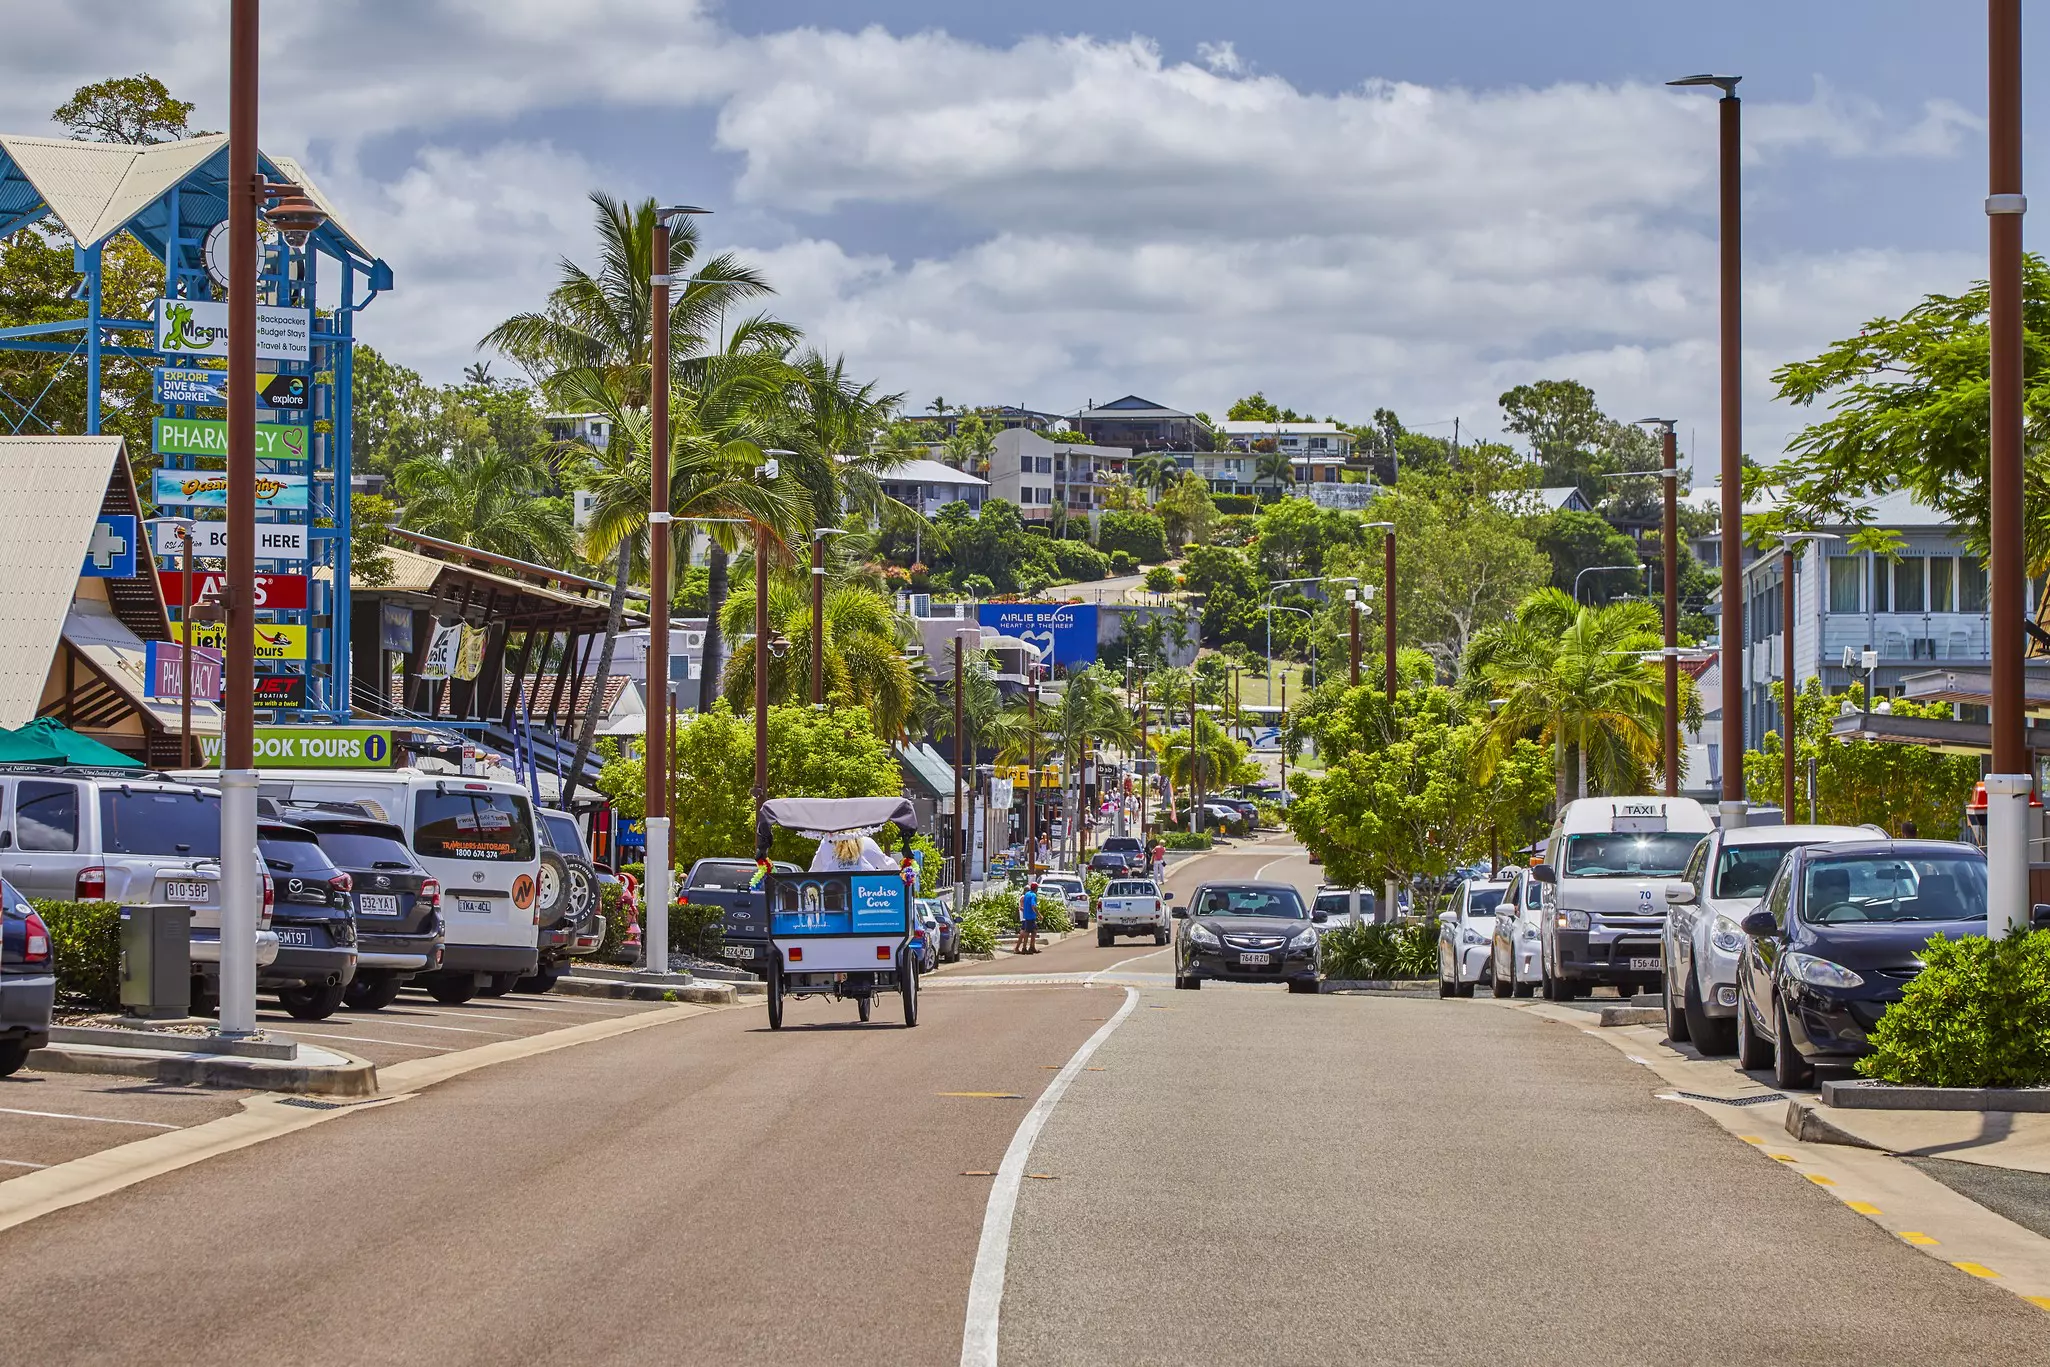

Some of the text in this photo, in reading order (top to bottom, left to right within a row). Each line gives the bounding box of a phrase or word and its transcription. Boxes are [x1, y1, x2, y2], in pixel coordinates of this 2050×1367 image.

[260, 314, 306, 325] Backpackers
[260, 327, 306, 339] Budget Stays
[260, 341, 307, 352] Travel & Tours
[163, 372, 209, 383] EXPLORE
[163, 381, 196, 392] DIVE &
[163, 391, 210, 402] SNORKEL
[272, 394, 304, 406] explore
[162, 425, 278, 453] PHARMCY
[262, 533, 300, 549] HERE
[199, 576, 267, 605] AS
[1000, 613, 1074, 622] AIRLIE BEACH
[162, 661, 213, 697] PHAACY
[202, 737, 361, 759] W OOK TOURS
[1626, 805, 1654, 815] TAXI
[455, 848, 472, 857] 1800
[472, 849, 485, 858] 674
[486, 850, 498, 859] 374
[1501, 870, 1518, 879] TA
[857, 885, 898, 899] Paradise
[1639, 890, 1652, 900] 70
[866, 896, 891, 908] Cove
